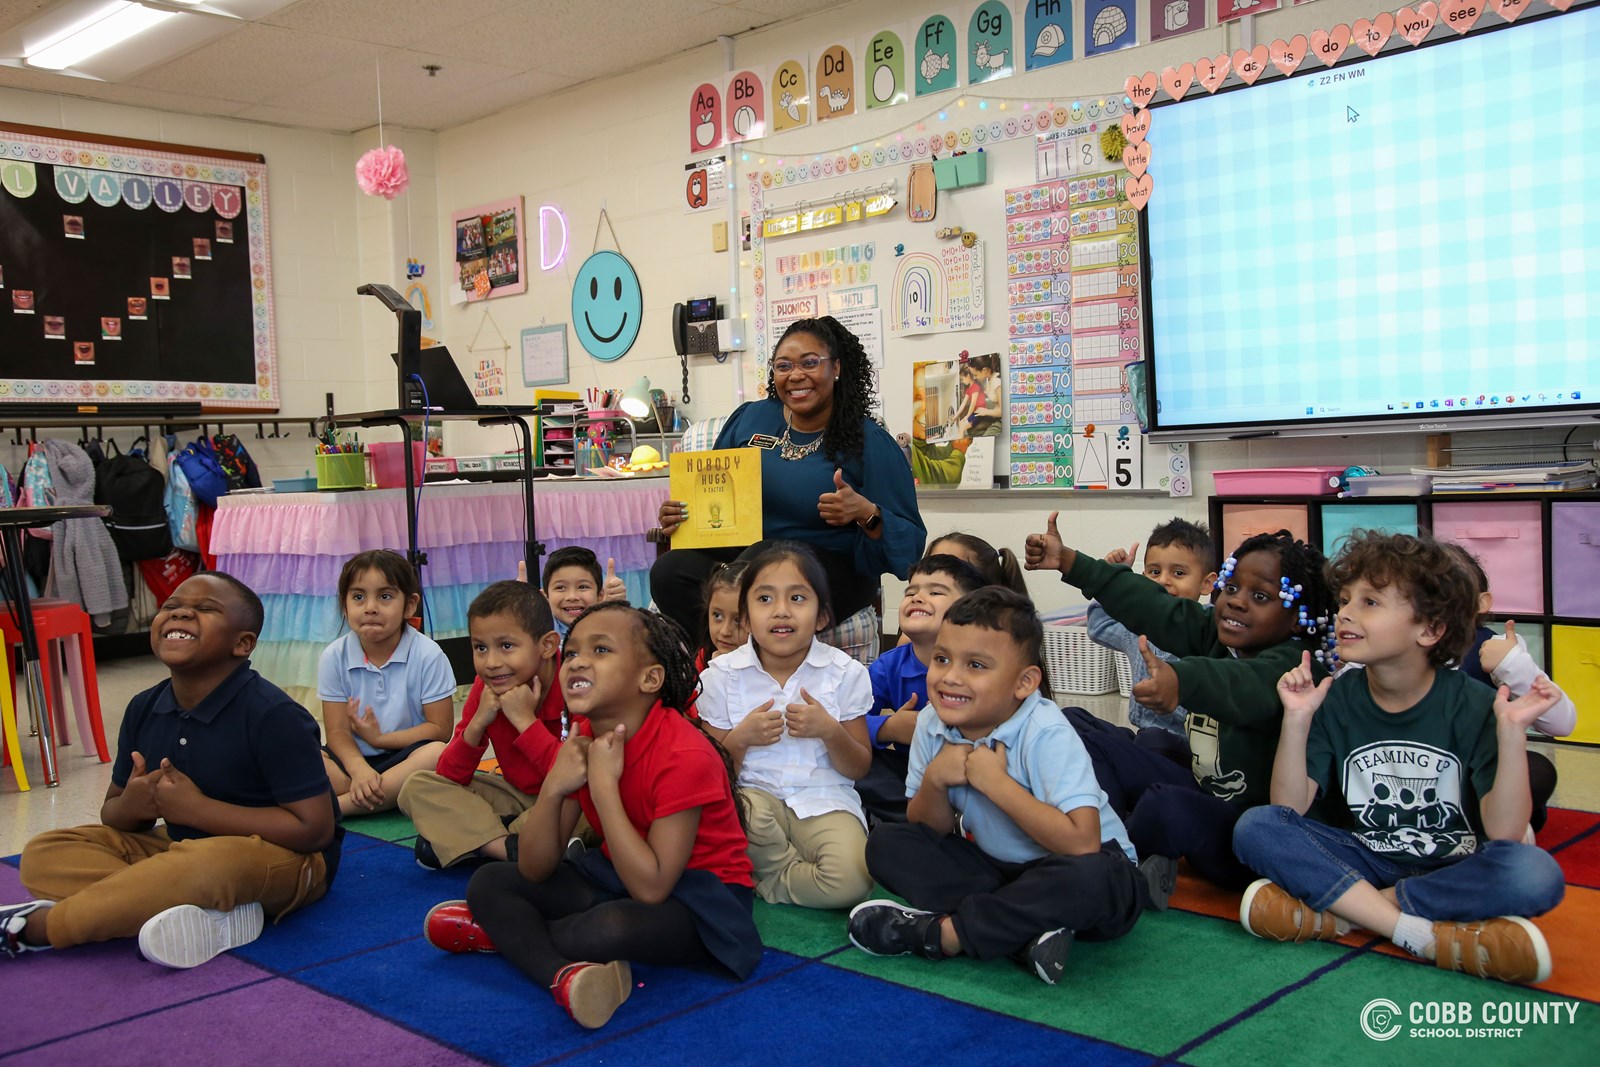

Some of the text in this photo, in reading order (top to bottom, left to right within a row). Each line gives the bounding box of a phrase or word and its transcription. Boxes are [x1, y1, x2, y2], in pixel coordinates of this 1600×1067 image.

[1449, 7, 1477, 22] see
[977, 10, 1002, 37] Gg
[1403, 18, 1429, 35] you
[925, 21, 945, 48] Ff
[1366, 29, 1381, 43] to
[873, 39, 894, 63] Ee
[1322, 37, 1339, 53] do
[823, 51, 845, 77] Dd
[1283, 51, 1294, 63] is
[1209, 65, 1216, 80] I
[1243, 62, 1258, 72] as
[779, 69, 798, 88] Cc
[1174, 78, 1182, 88] a
[1319, 68, 1365, 86] Z2 FN WM
[734, 78, 755, 100] Bb
[1132, 84, 1151, 98] the
[696, 92, 714, 111] Aa
[1067, 126, 1088, 137] SCHOOL
[1126, 122, 1146, 135] have
[1081, 143, 1093, 166] 8
[1128, 155, 1147, 167] little
[63, 173, 233, 211] VALLEY
[1117, 176, 1128, 193] 11
[1130, 187, 1148, 198] what
[1051, 186, 1067, 206] 10
[1117, 208, 1137, 225] 120
[1051, 217, 1070, 236] 20
[539, 205, 568, 271] D
[1051, 248, 1070, 266] 30
[1117, 242, 1139, 258] 130
[1051, 279, 1071, 297] 40
[1117, 272, 1139, 289] 140
[909, 291, 919, 305] 10
[777, 300, 811, 317] PHONICS
[1117, 306, 1140, 322] 150
[1051, 311, 1071, 328] 50
[1052, 342, 1071, 358] 60
[1119, 336, 1140, 351] 160
[1053, 372, 1071, 389] 70
[1053, 403, 1072, 420] 80
[1053, 433, 1072, 450] 90
[687, 456, 741, 473] NOBODY
[1054, 464, 1073, 479] 100
[1115, 459, 1132, 487] 5
[702, 473, 727, 485] HUGS
[1353, 750, 1451, 773] TEAMING UP
